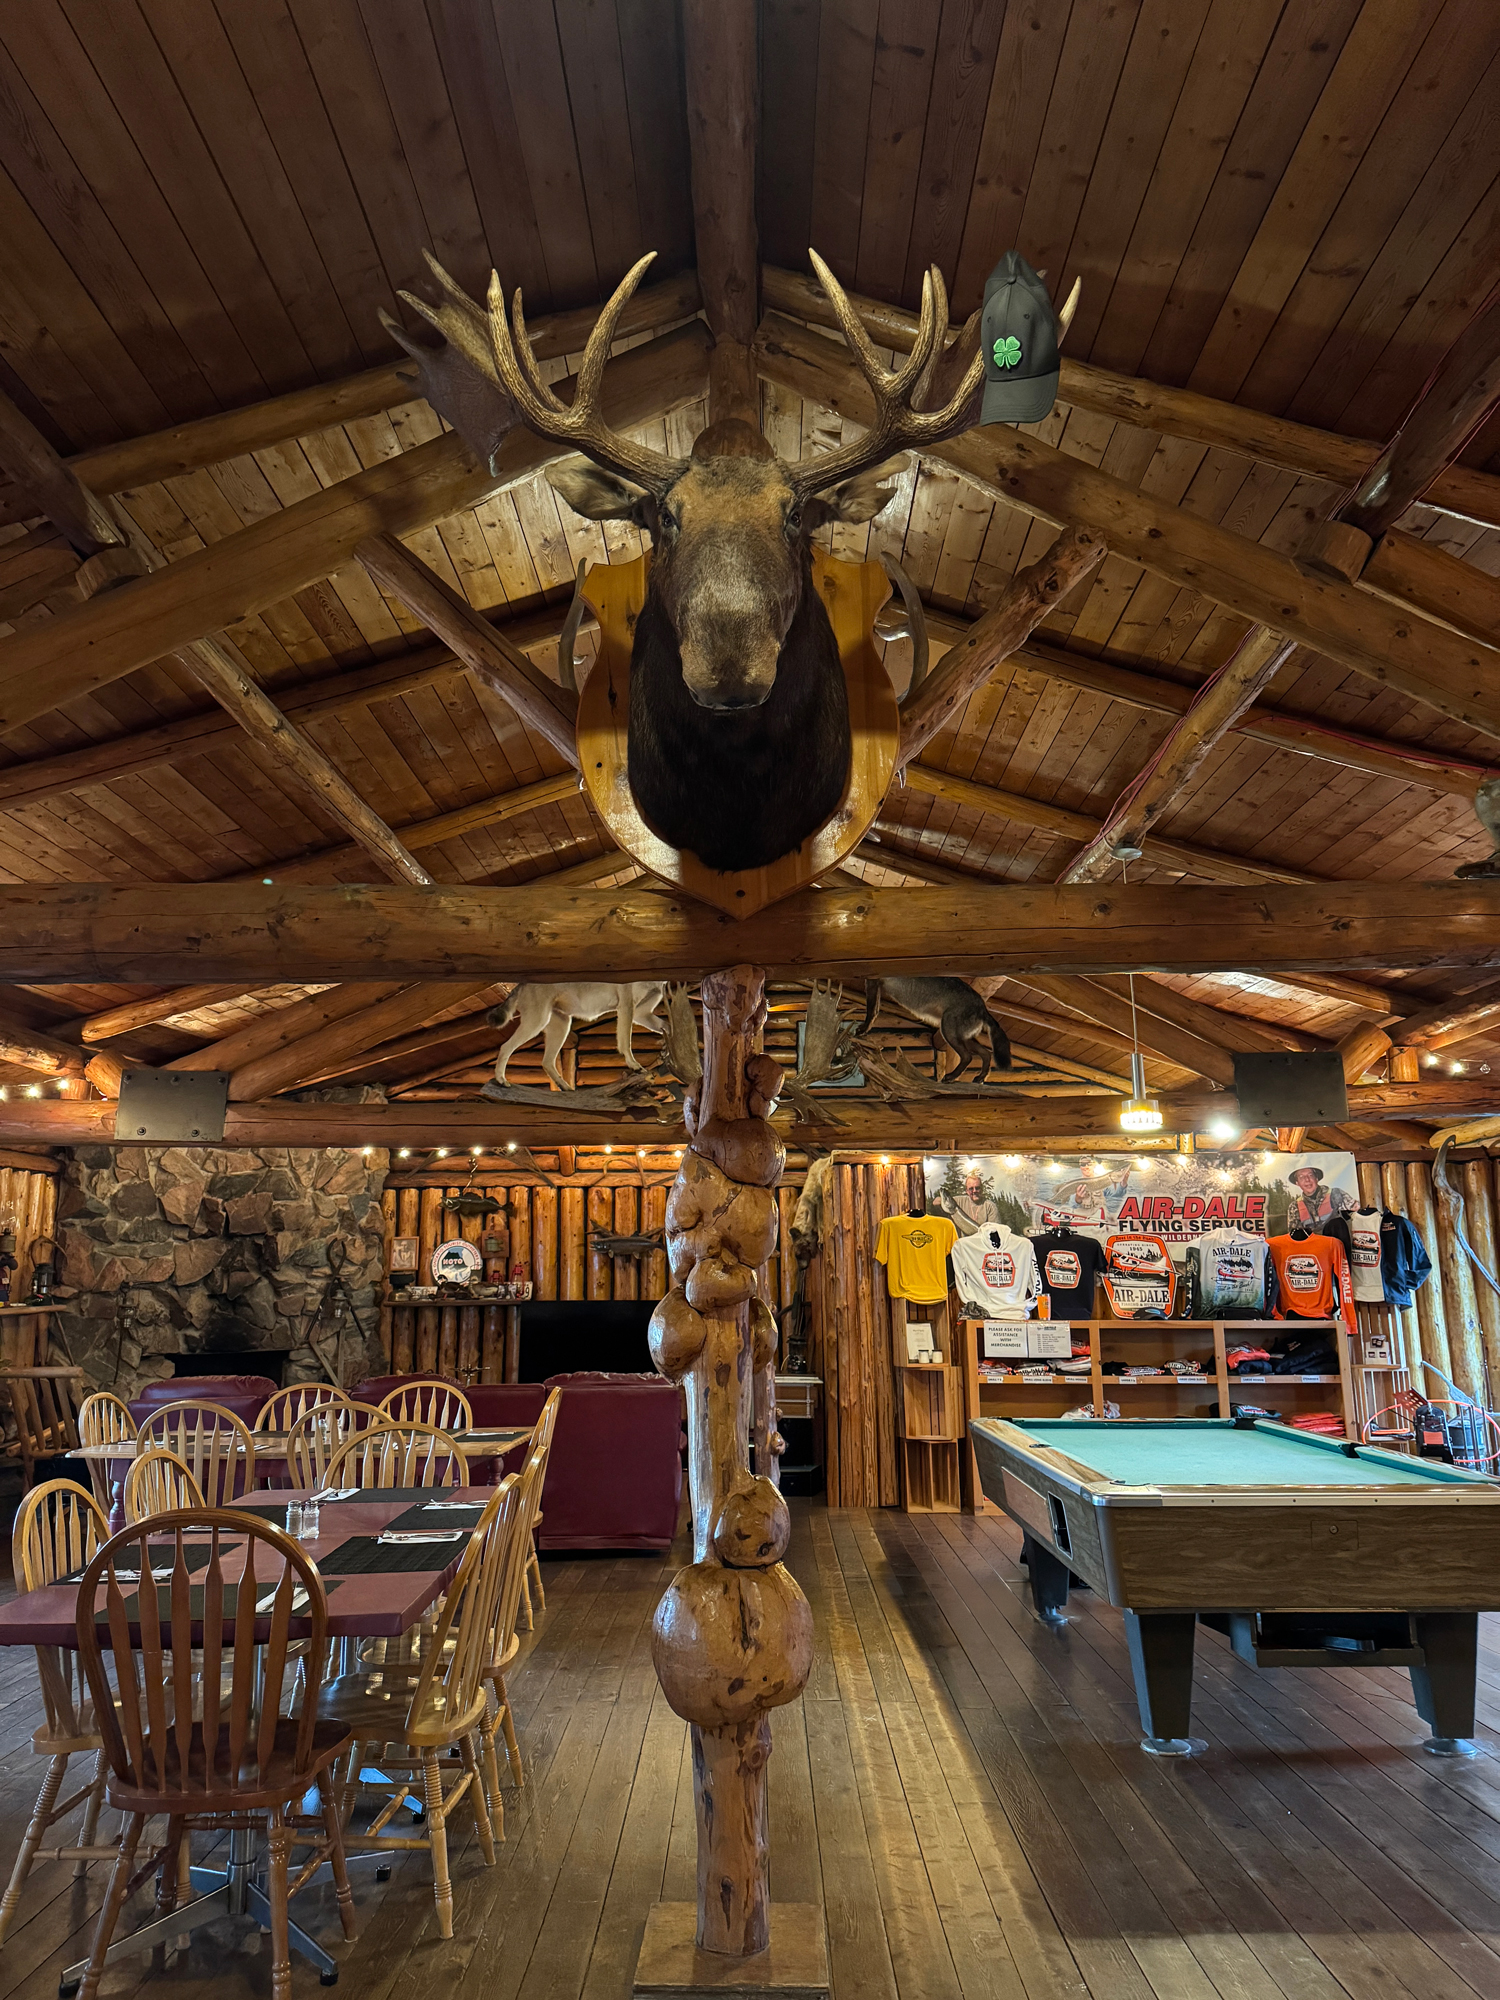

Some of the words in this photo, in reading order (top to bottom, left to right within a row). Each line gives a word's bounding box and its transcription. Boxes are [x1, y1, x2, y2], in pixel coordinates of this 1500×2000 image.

[1117, 1196, 1265, 1220] AIR-DALE
[1118, 1219, 1183, 1232] FLYING
[1189, 1219, 1265, 1232] SERVICE
[1160, 1233, 1202, 1242] WILDERN
[1212, 1247, 1252, 1258] AIR-DALE
[1050, 1274, 1076, 1282] AIR-DALE
[1291, 1278, 1318, 1286] AIR-DALE
[1340, 1257, 1353, 1304] AIR-DALE
[1114, 1289, 1170, 1303] AIR-DALE
